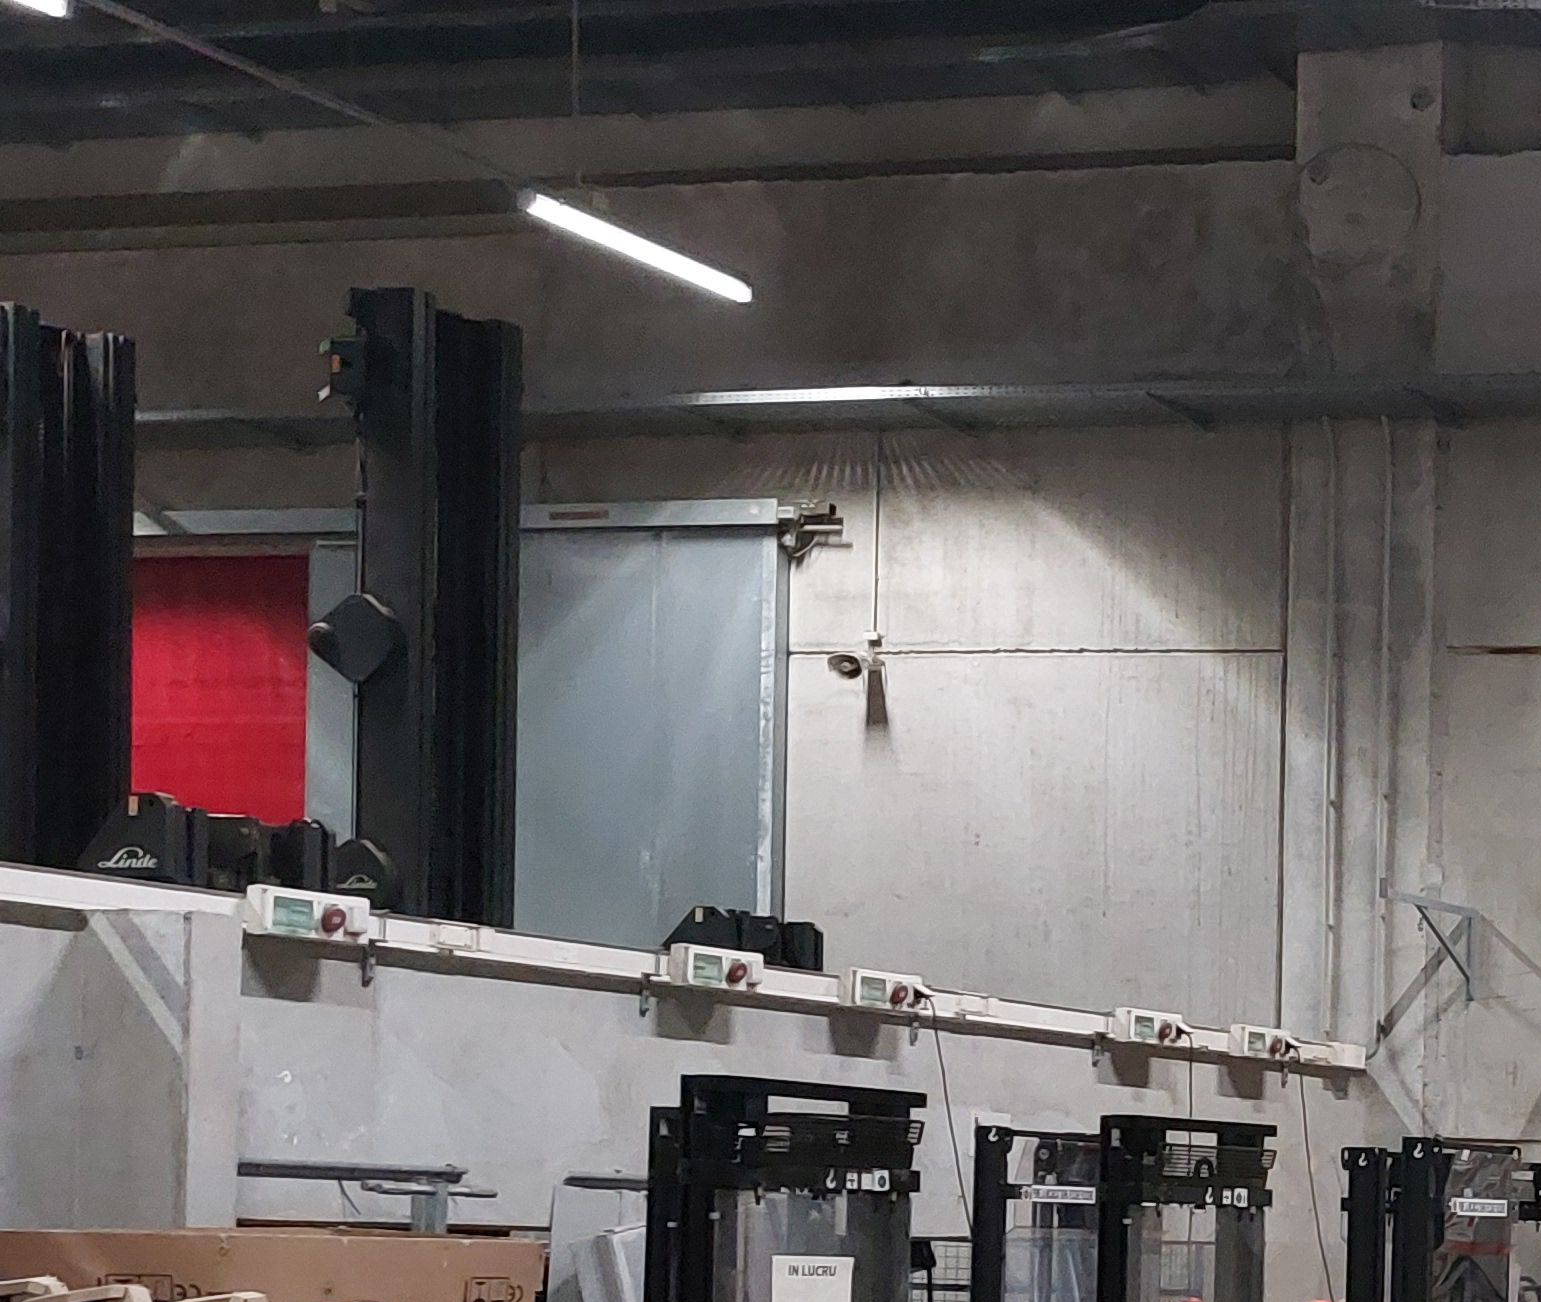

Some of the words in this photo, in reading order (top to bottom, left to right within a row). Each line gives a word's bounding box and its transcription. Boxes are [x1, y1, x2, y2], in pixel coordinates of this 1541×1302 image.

[97, 846, 158, 869] Linde
[788, 1265, 799, 1276] IN
[801, 1265, 837, 1277] LUCRU
